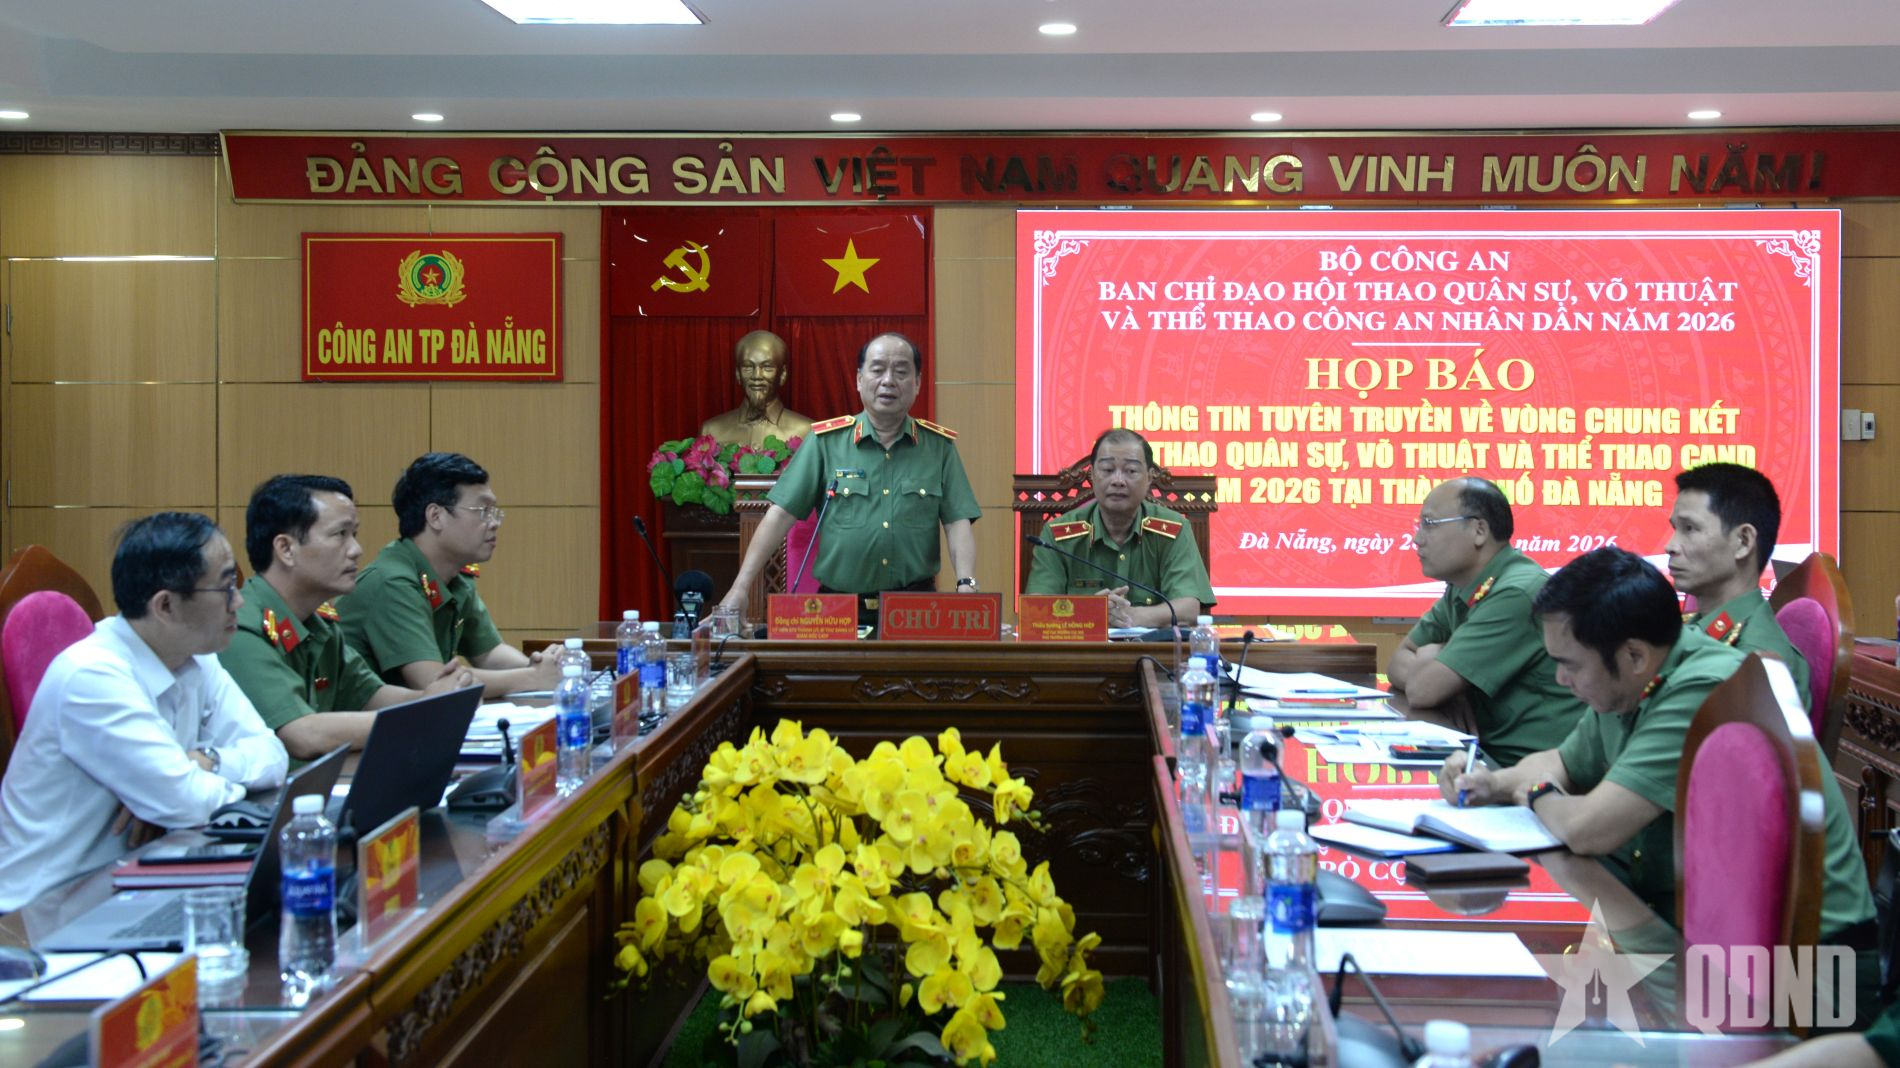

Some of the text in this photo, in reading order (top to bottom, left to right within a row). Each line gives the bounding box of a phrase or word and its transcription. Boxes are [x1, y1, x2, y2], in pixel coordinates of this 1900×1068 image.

[305, 142, 464, 194] ĐẢNG
[488, 146, 650, 200] CỘNG
[672, 142, 786, 195] SẢN
[813, 144, 936, 200] VIỆT
[959, 155, 1078, 195] NAM
[1105, 153, 1304, 194] QUANG
[1328, 154, 1455, 193] VINH
[1481, 144, 1647, 193] MUÔN
[1319, 245, 1510, 276] BỘ CÔNG AN
[1098, 275, 1738, 306] BAN CHỈ ĐẠO HỘI THAO QUÂN SỰ, VÕ THUẬT
[1101, 302, 1736, 331] VÀ THỂ THAO CÔNG AN NHÂN DÂN NĂM 2026
[318, 316, 546, 364] CÔNG AN TP ĐÀ NẴNG
[1304, 348, 1536, 399] HỌP BÁO
[1108, 398, 1740, 434] THÔNG TIN TUYÊN TRUYỀN VỀ VÒNG CHUNG KẾT
[1151, 435, 1756, 473] THAO QUÂN SỰ, VÕ THUẬT VÀ THỂ THAO CAND
[1250, 477, 1321, 504] 2026
[1328, 478, 1372, 508] TẠI
[1380, 475, 1449, 505] THÀ
[1492, 471, 1534, 505] HỐ
[1542, 476, 1580, 506] ĐÀ
[1588, 473, 1663, 506] NẴNG
[1239, 531, 1269, 550] Đà
[1275, 528, 1337, 553] Nẵng,
[1343, 532, 1394, 555] ngày
[1514, 535, 1561, 552] năm
[888, 602, 990, 630] CHỦ TRÌ
